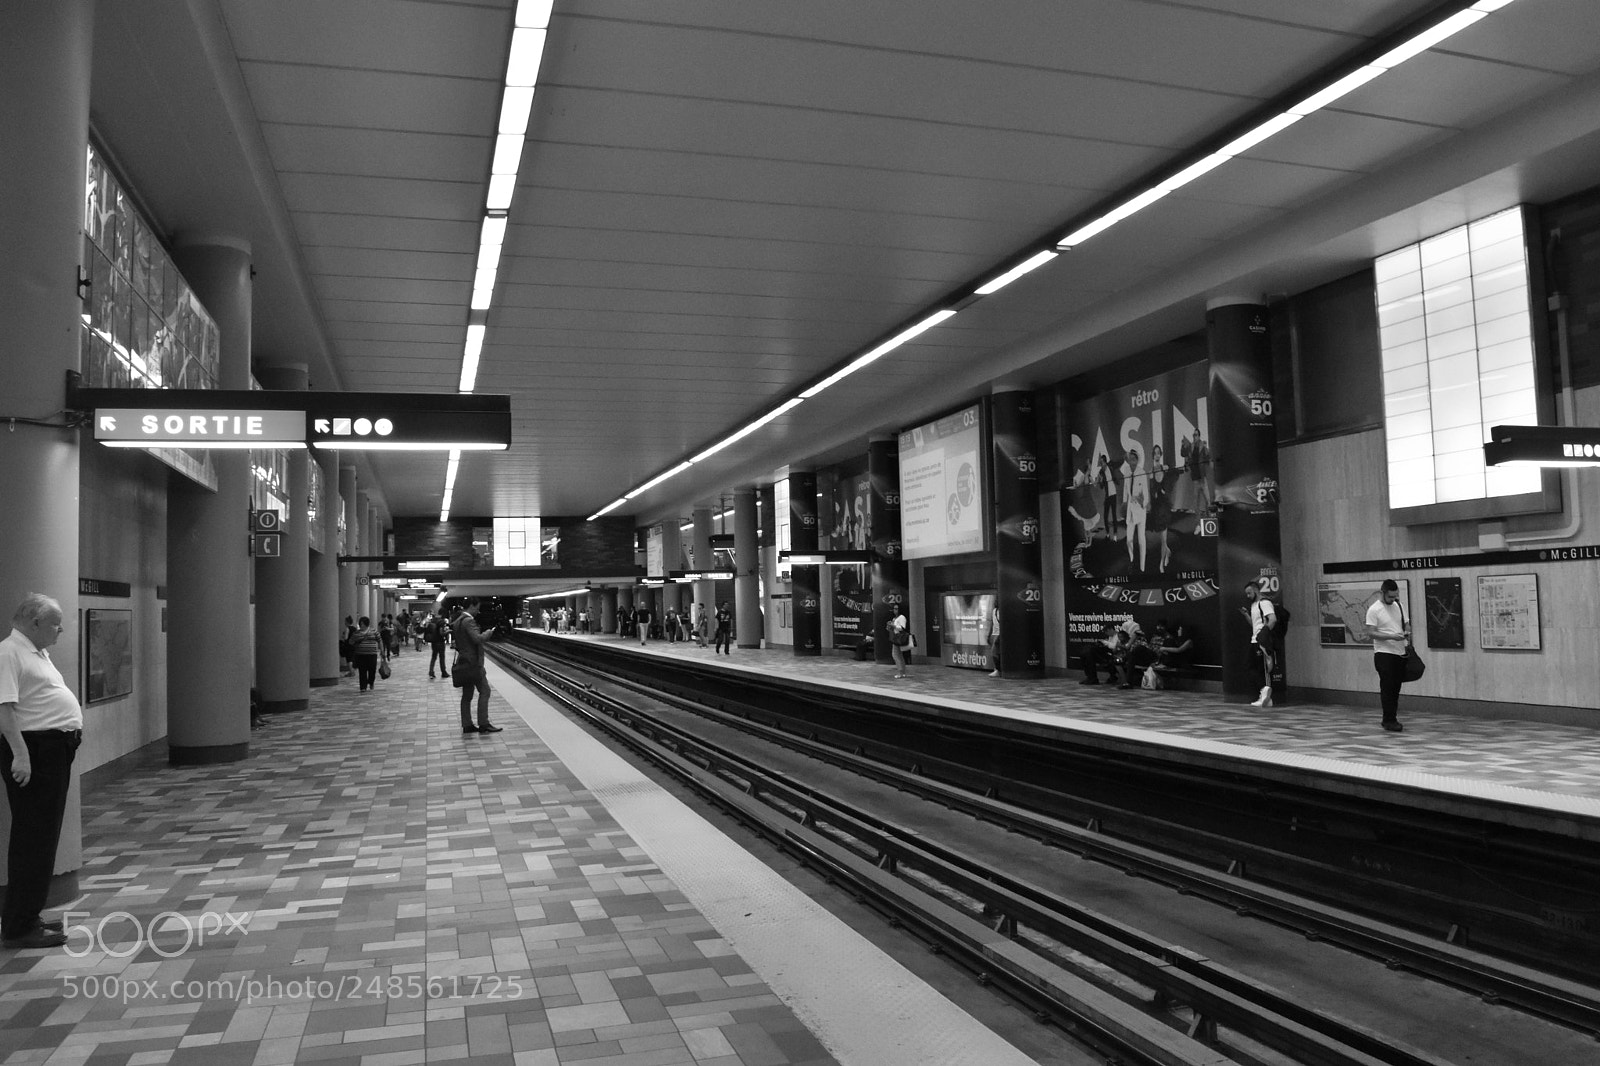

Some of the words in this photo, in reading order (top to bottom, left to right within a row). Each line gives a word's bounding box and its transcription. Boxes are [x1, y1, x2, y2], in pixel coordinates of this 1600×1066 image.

[1131, 388, 1160, 409] rétro
[1250, 399, 1273, 416] 50
[141, 415, 264, 436] SORTIE
[963, 410, 975, 427] 03
[1018, 459, 1037, 473] 50
[803, 516, 816, 526] 50
[1551, 545, 1600, 560] McGILL
[1401, 557, 1439, 569] McGILL
[1182, 570, 1206, 579] McGILL
[1258, 577, 1280, 593] 20
[804, 598, 816, 608] 20
[887, 595, 903, 605] 20
[1025, 590, 1041, 602] 20
[1119, 589, 1140, 604] 28
[1068, 612, 1085, 622] Venez
[1085, 612, 1104, 622] revivre
[1103, 612, 1113, 622] les
[1112, 612, 1133, 622] années
[1077, 623, 1086, 632] 50
[1086, 624, 1092, 632] et
[1091, 623, 1100, 632] 80
[952, 650, 969, 664] c'est
[968, 650, 987, 666] rétro
